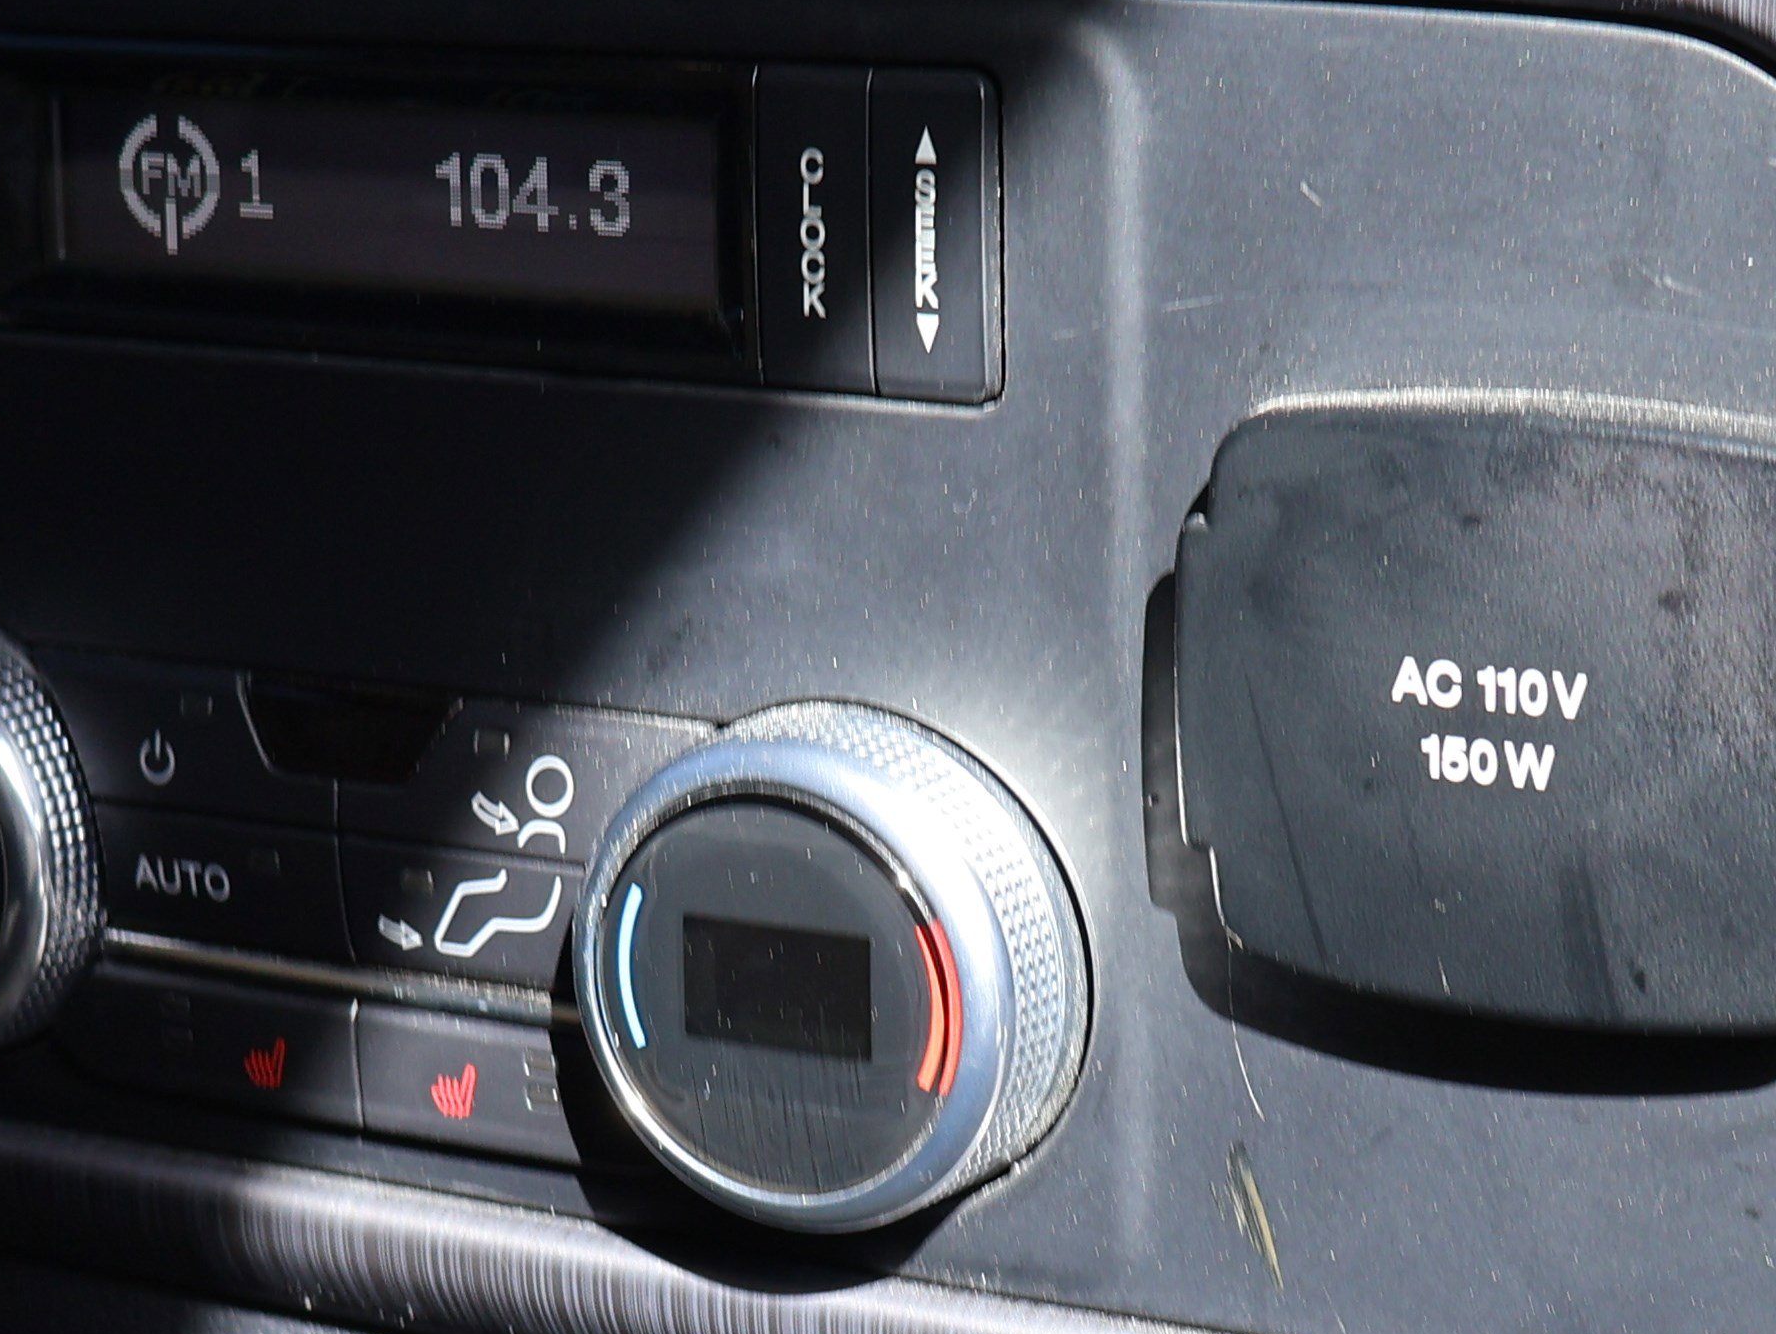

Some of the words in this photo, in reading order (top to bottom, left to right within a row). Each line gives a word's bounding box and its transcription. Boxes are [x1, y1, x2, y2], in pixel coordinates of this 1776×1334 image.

[140, 151, 203, 198] FM
[239, 148, 274, 220] 1
[434, 151, 631, 237] 104.3
[799, 146, 826, 319] CLOCK
[914, 168, 940, 310] SEEK
[1391, 655, 1463, 709] AC
[135, 852, 231, 903] AUTO
